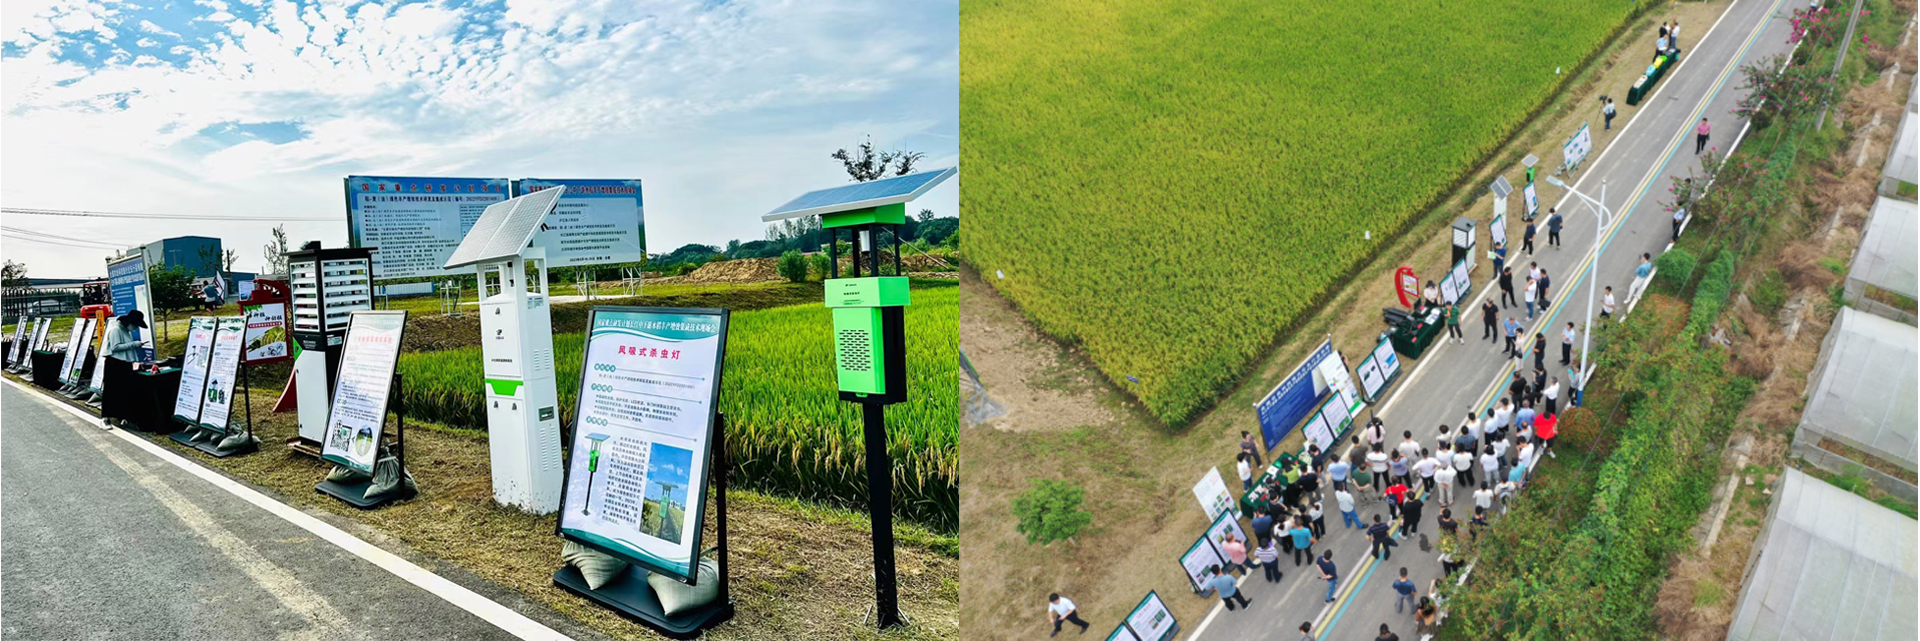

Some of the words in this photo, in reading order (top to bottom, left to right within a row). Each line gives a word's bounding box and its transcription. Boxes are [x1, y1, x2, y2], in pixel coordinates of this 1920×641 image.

[618, 345, 681, 360] 风吸式杀虫灯
